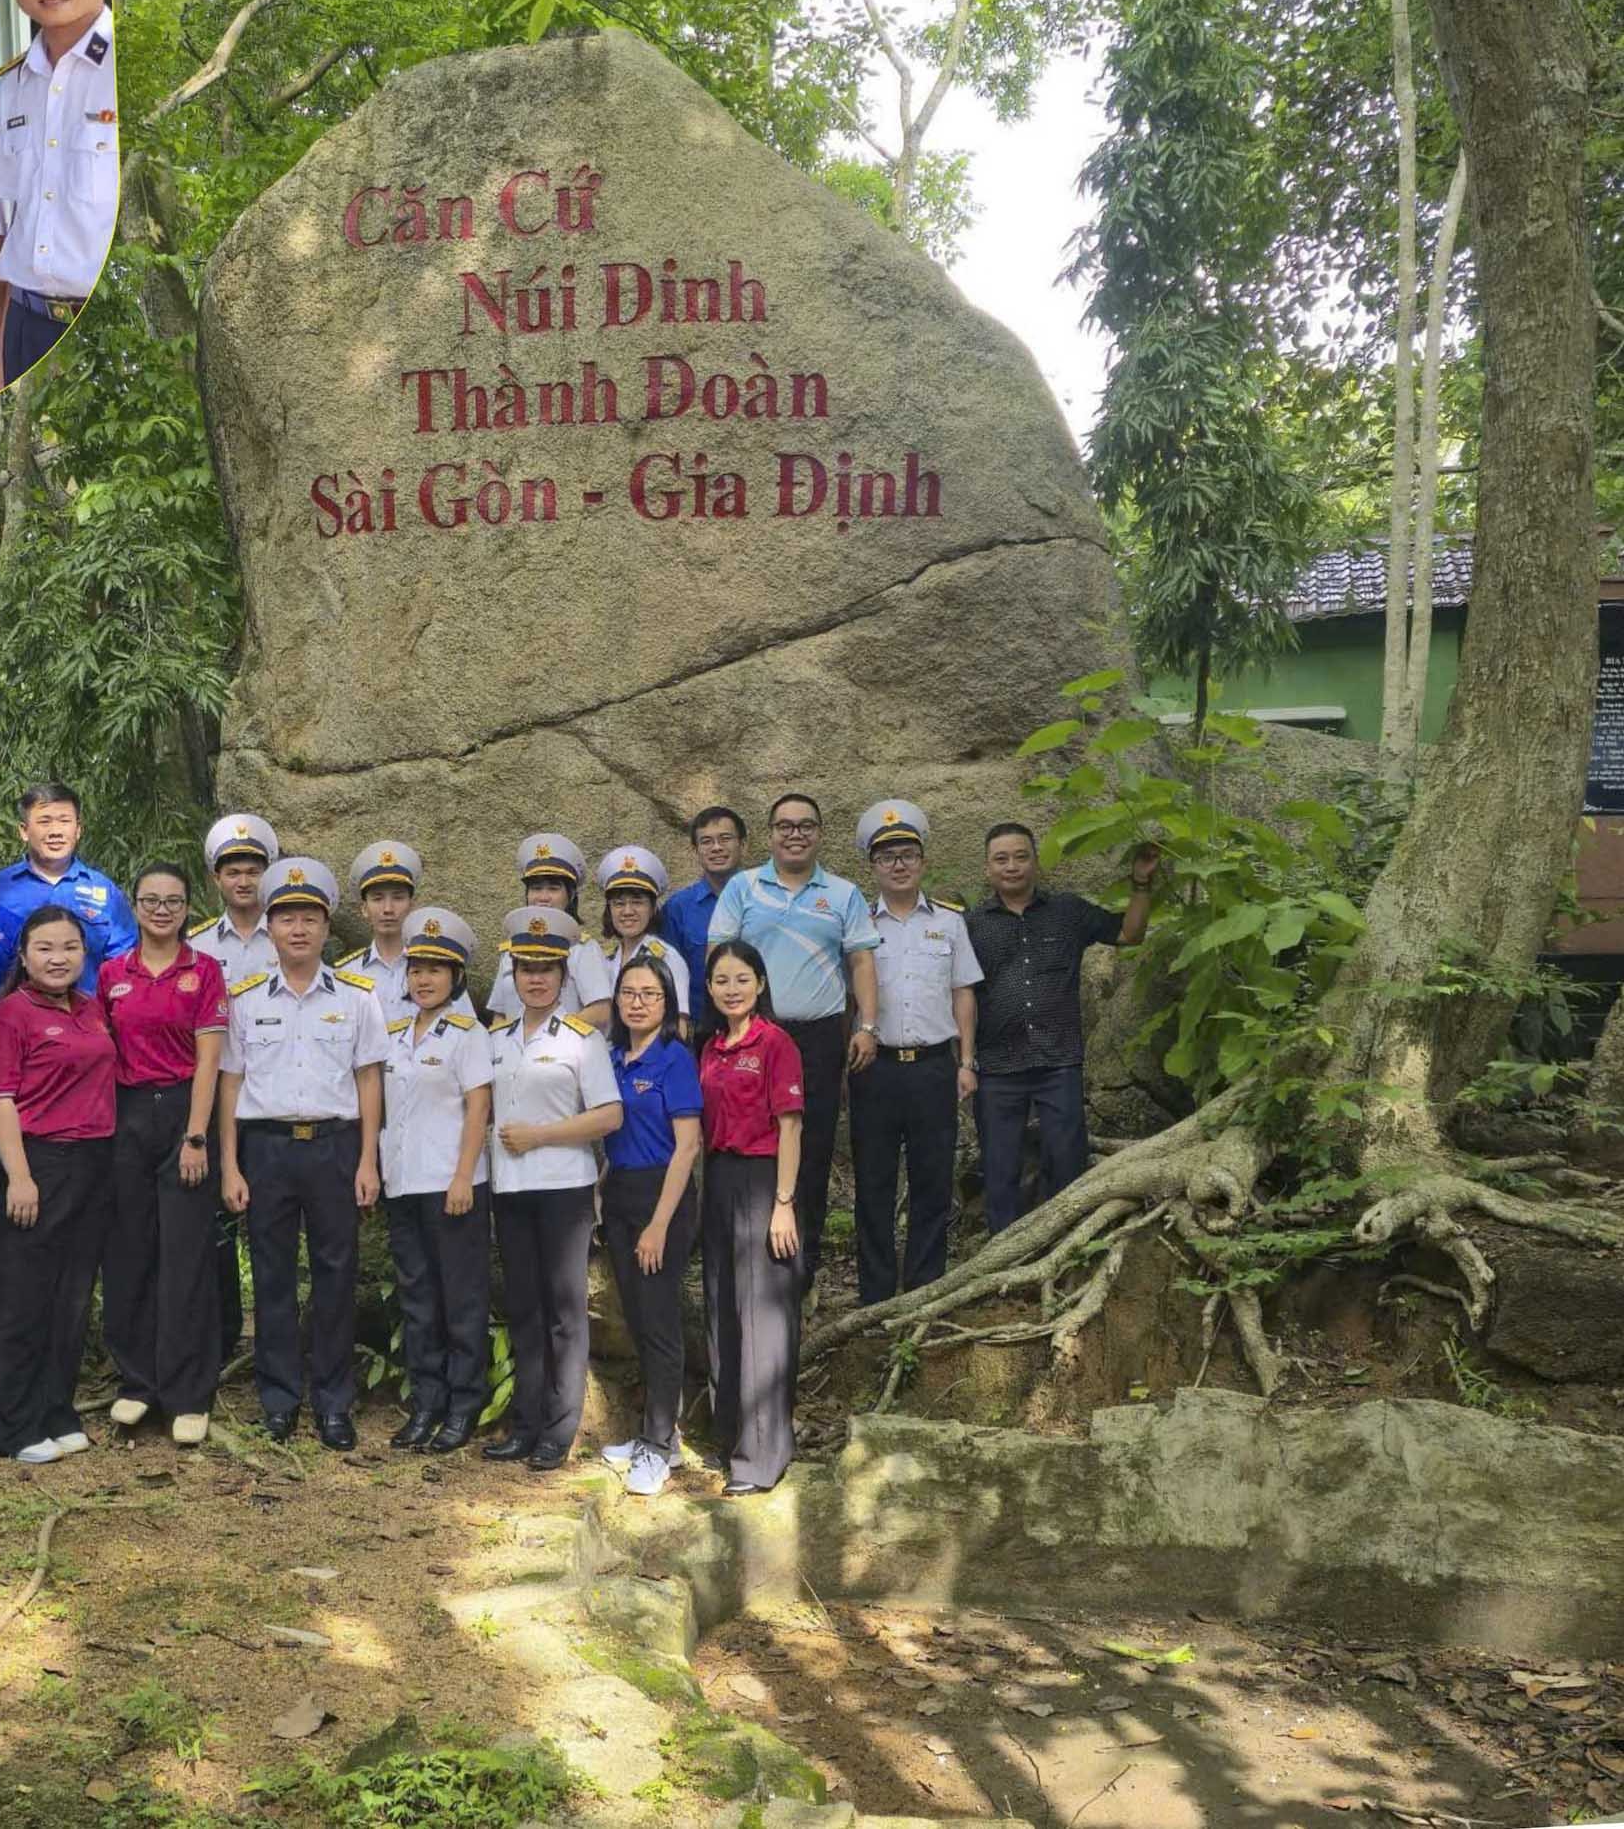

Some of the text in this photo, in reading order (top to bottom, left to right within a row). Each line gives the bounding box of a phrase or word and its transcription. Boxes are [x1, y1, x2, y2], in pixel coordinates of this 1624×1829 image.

[344, 164, 604, 250] Căn Cứ
[458, 259, 769, 336] Núi Dinh
[402, 351, 829, 434] Thành Đoàn
[309, 469, 397, 539] Sài
[417, 460, 560, 530] Gòn
[629, 452, 751, 520] Gia
[775, 452, 945, 534] Định
